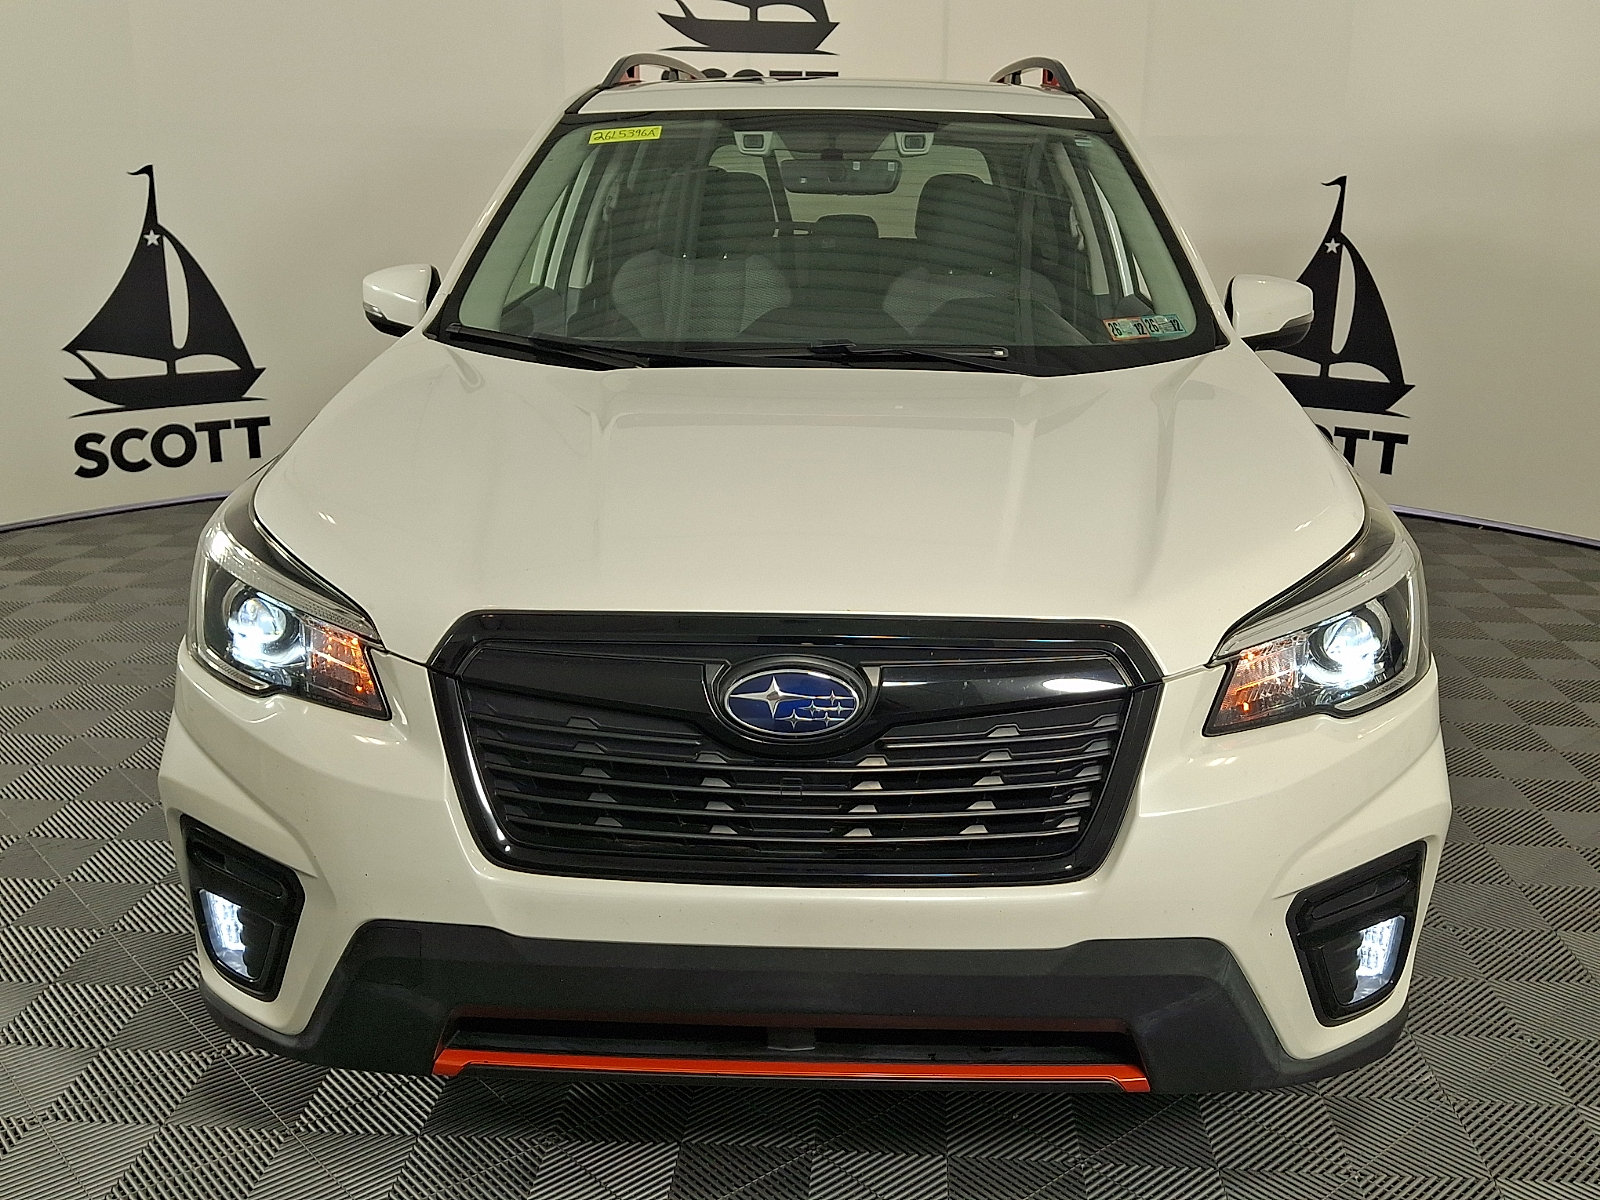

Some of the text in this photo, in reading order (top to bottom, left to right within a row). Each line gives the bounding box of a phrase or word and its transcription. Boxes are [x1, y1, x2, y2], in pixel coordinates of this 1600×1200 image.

[1108, 322, 1122, 336] 26
[1133, 322, 1147, 335] 12
[1145, 318, 1159, 332] 26
[1169, 319, 1183, 332] 12
[74, 416, 271, 478] SCOTT
